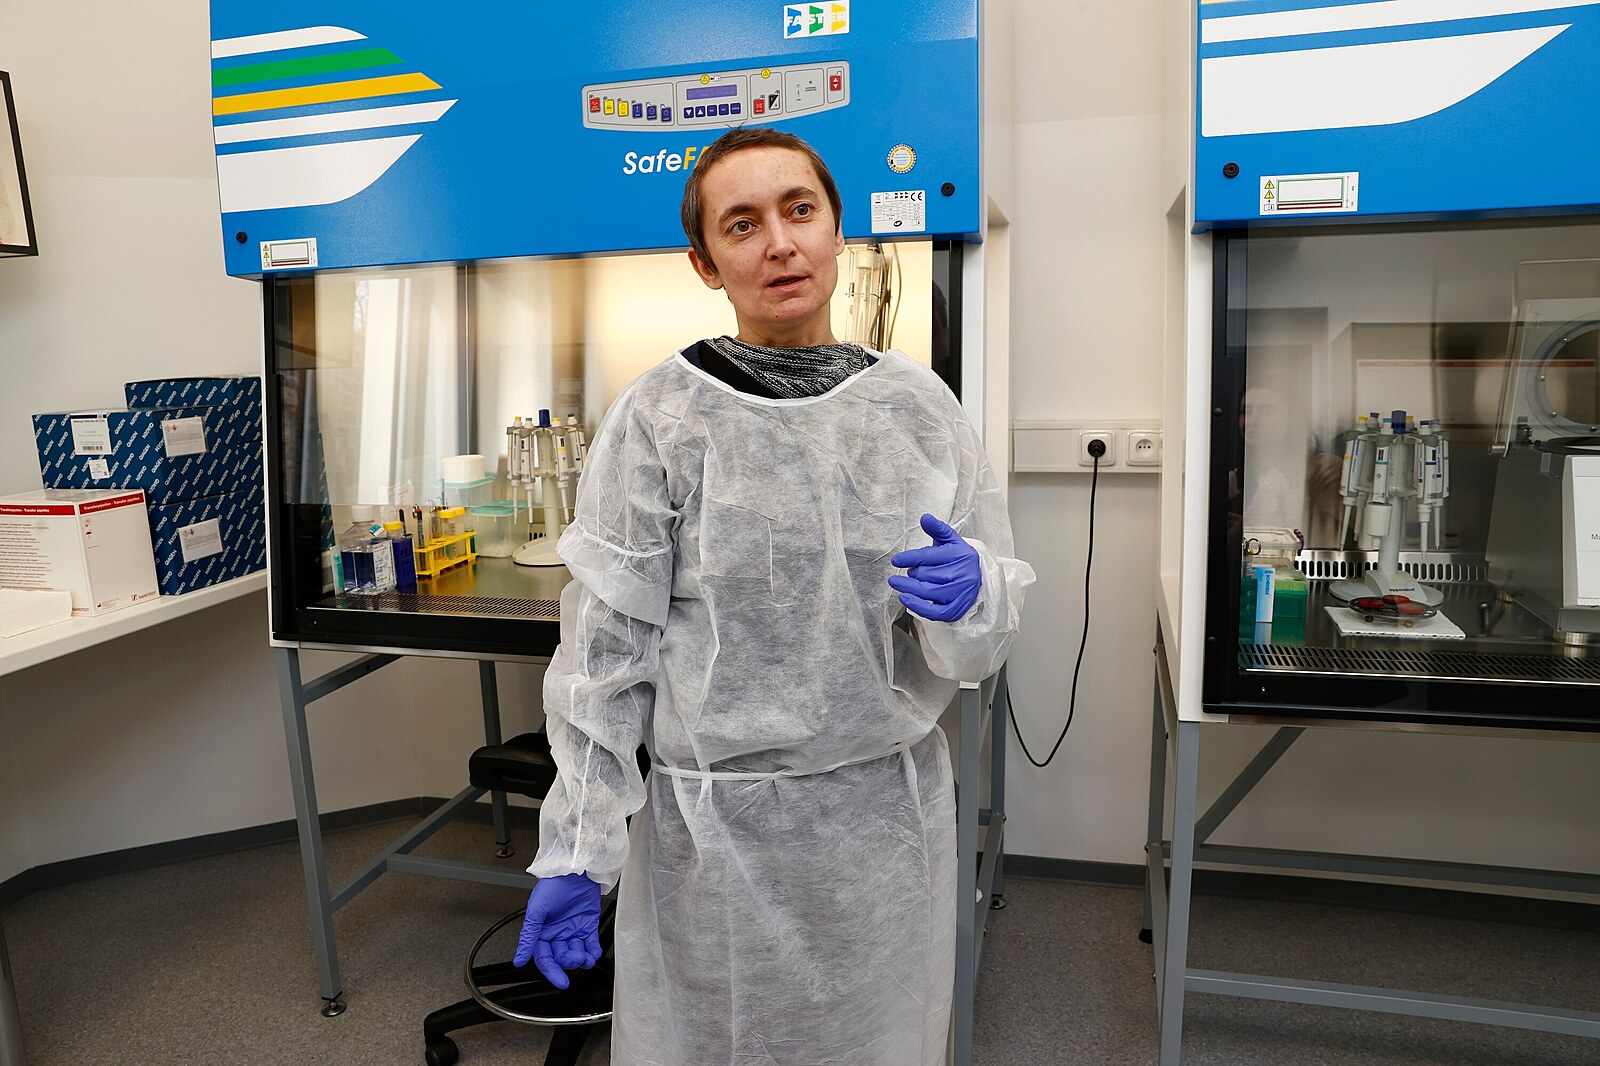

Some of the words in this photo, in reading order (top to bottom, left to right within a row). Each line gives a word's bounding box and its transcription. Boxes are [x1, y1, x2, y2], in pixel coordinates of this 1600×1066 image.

[141, 387, 152, 402] QIAGEN
[180, 382, 192, 398] QIAGEN
[206, 386, 217, 402] QIAGEN
[248, 381, 258, 396] QIAGEN
[166, 390, 177, 406] QIAGEN
[232, 390, 244, 404] QIAGEN
[244, 400, 254, 416] QIAGEN
[46, 419, 56, 435] QIAGEN
[114, 418, 126, 434] QIAGEN
[142, 422, 154, 438] QIAGEN
[214, 416, 225, 433] QIAGEN
[240, 420, 251, 437] QIAGEN
[58, 432, 68, 447] QIAGEN
[126, 431, 138, 448] QIAGEN
[225, 428, 236, 444] QIAGEN
[44, 440, 54, 455] QIAGEN
[139, 444, 150, 460] QIAGEN
[211, 438, 222, 454] QIAGEN
[55, 452, 66, 468] QIAGEN
[123, 452, 134, 469] QIAGEN
[152, 457, 164, 473] QIAGEN
[222, 449, 232, 465] QIAGEN
[240, 455, 250, 470] QIAGEN
[67, 465, 78, 480] QIAGEN
[136, 466, 147, 482] QIAGEN
[180, 458, 192, 474] QIAGEN
[208, 458, 218, 475] QIAGEN
[251, 464, 262, 481] QIAGEN
[164, 468, 176, 485] QIAGEN
[192, 469, 203, 486] QIAGEN
[218, 469, 228, 486] QIAGEN
[148, 478, 159, 494] QIAGEN
[176, 480, 188, 496] QIAGEN
[203, 480, 214, 496] QIAGEN
[247, 485, 258, 502] QIAGEN
[172, 505, 184, 522] QIAGEN
[200, 504, 211, 521] QIAGEN
[226, 504, 236, 520] QIAGEN
[156, 516, 167, 532] QIAGEN
[236, 514, 246, 530] QIAGEN
[224, 524, 234, 541] QIAGEN
[234, 534, 244, 550] QIAGEN
[164, 550, 177, 566] QIAGEN
[220, 546, 230, 562] QIAGEN
[204, 558, 216, 574] QIAGEN
[230, 555, 240, 572] QIAGEN
[190, 570, 201, 586] QIAGEN
